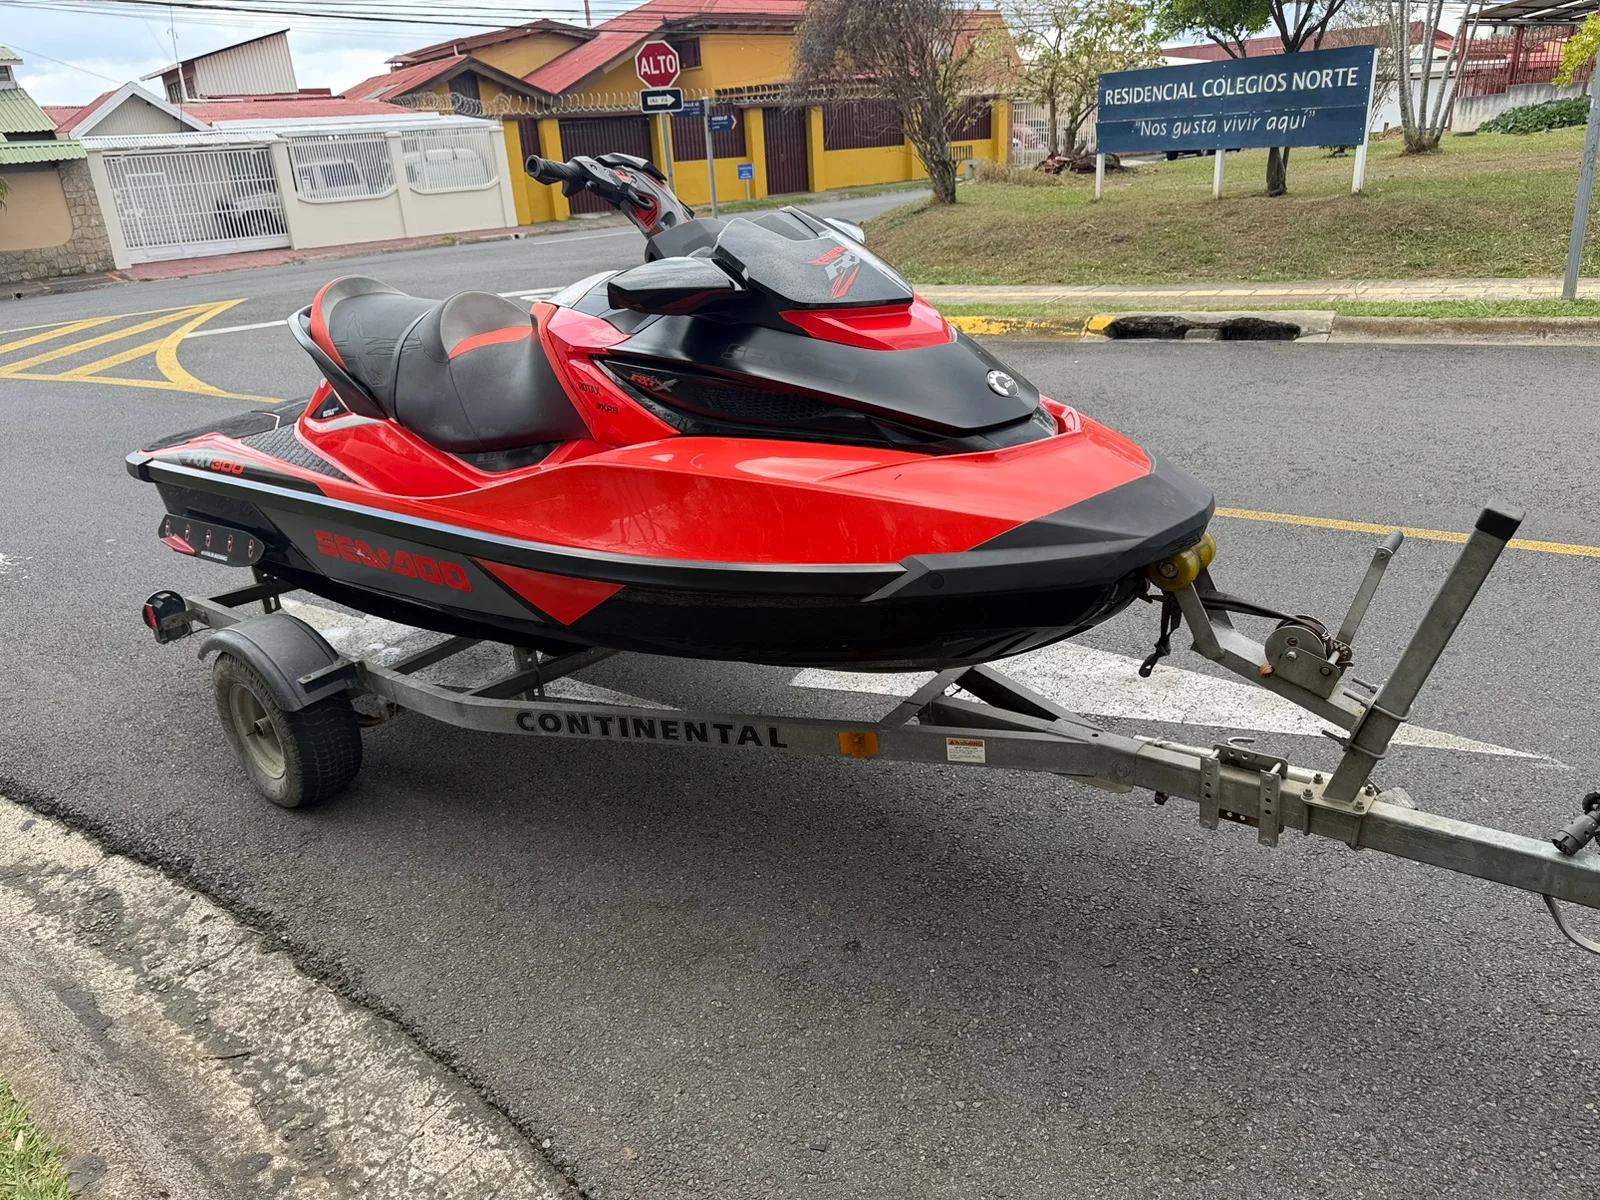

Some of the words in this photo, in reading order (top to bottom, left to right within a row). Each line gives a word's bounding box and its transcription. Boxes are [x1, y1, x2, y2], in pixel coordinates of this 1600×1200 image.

[640, 54, 676, 76] ALTO
[1105, 81, 1197, 106] RESIDENCIAL
[1201, 72, 1287, 98] COLEGIOS
[1292, 67, 1359, 91] NORTE
[1135, 120, 1167, 137] “Nos
[1171, 119, 1217, 139] gusta
[1223, 115, 1261, 133] vivir
[577, 380, 602, 397] ROTAX
[514, 710, 789, 749] CONTINENTAL
